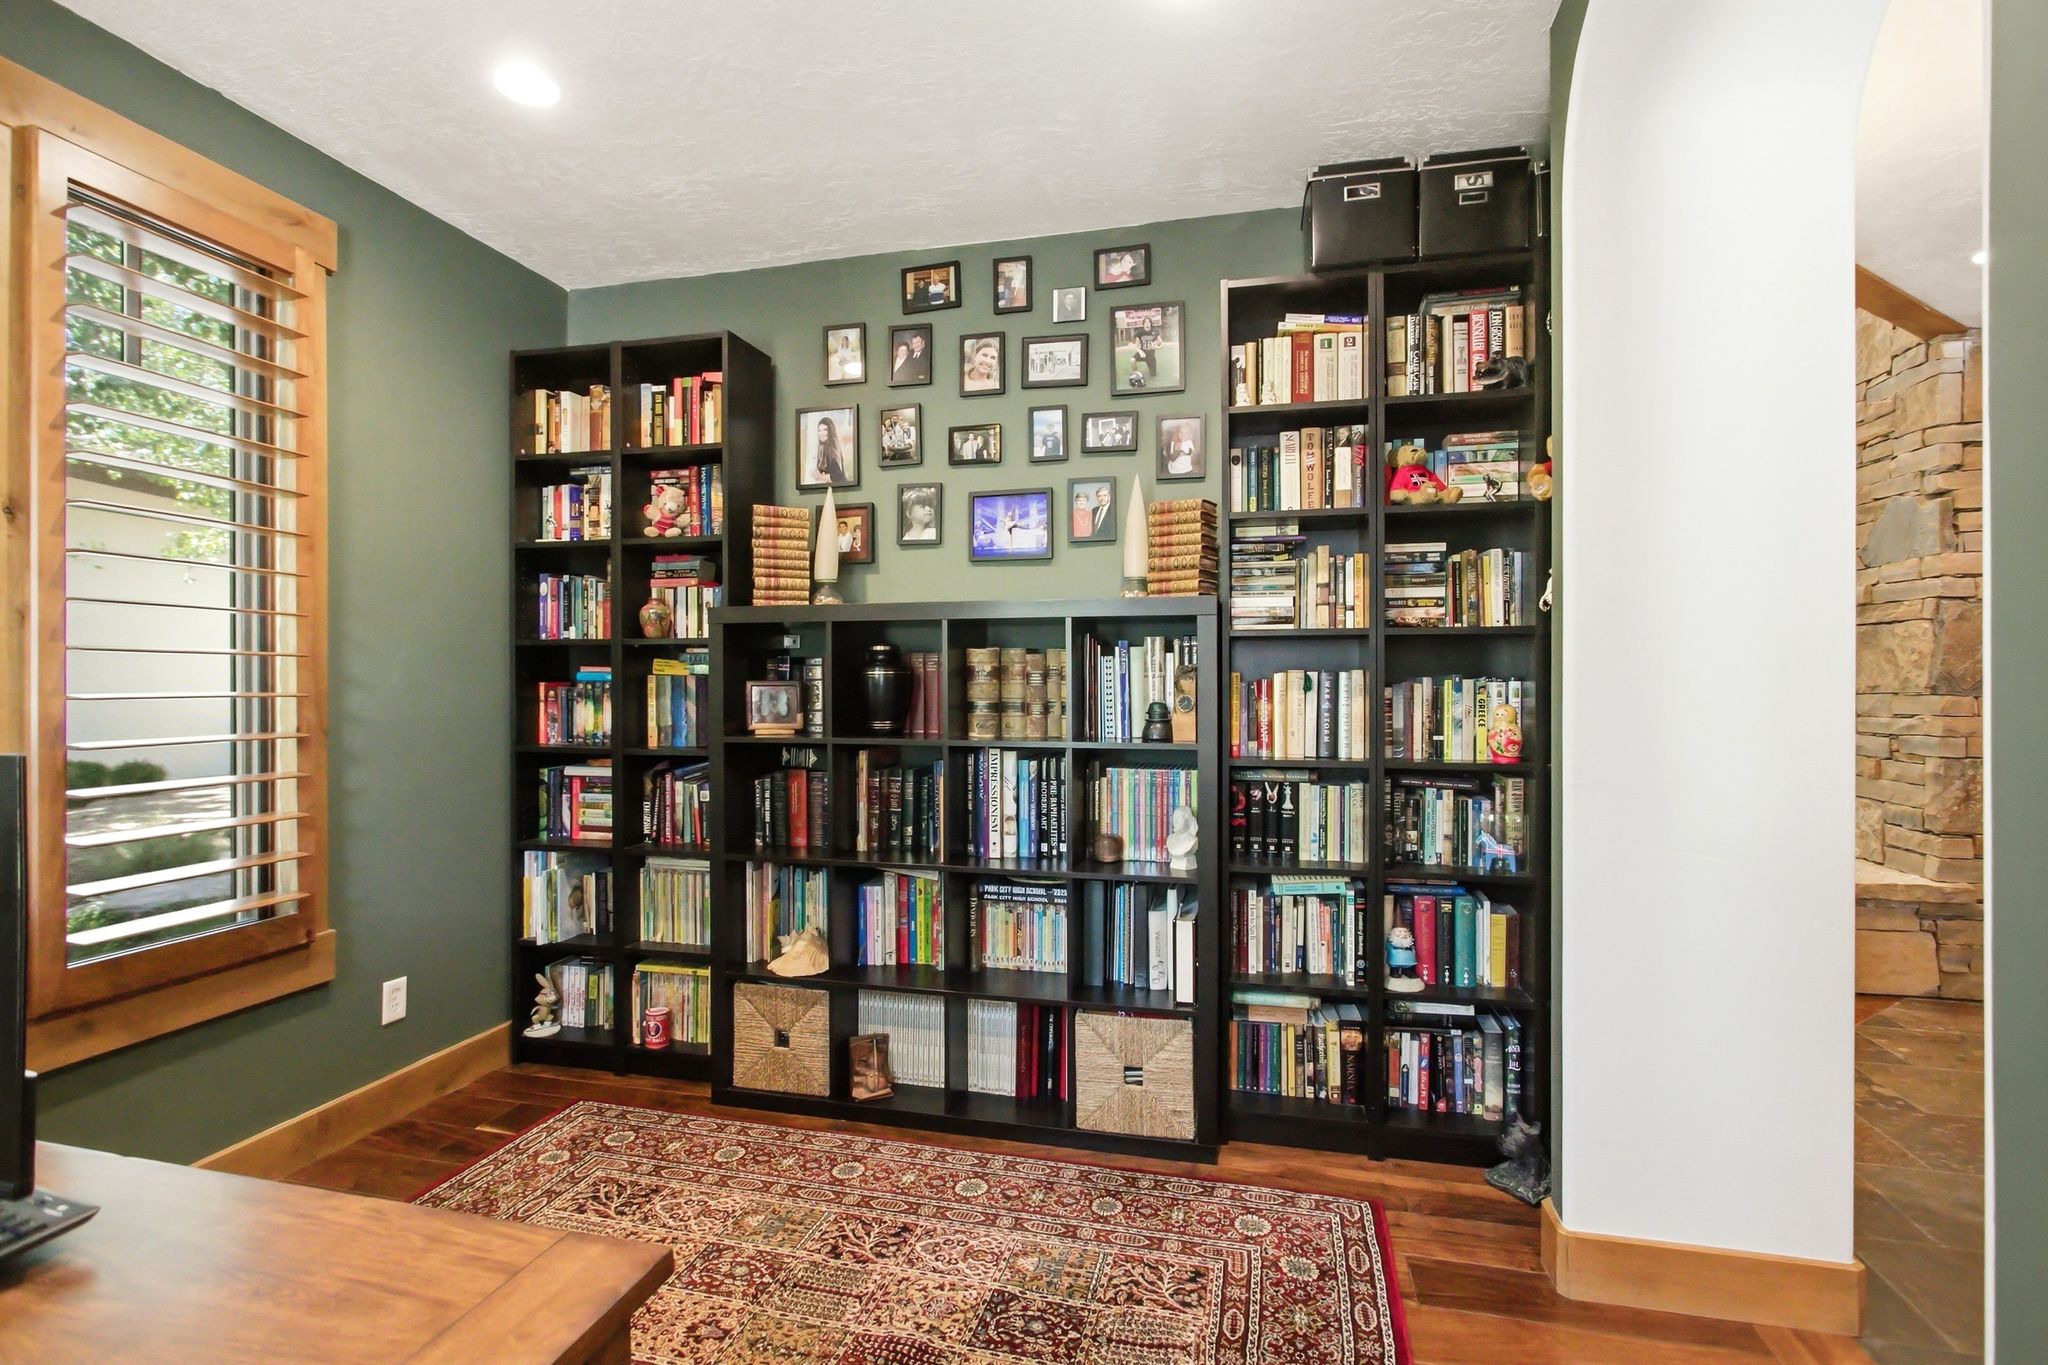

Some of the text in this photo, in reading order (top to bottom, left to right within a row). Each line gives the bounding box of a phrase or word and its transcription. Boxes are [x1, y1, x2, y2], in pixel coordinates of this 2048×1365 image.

[1324, 340, 1328, 348] 1
[1346, 338, 1353, 346] 2
[1472, 314, 1484, 351] BESTSELLER
[1491, 311, 1503, 352] JOHN GRISHAM
[1306, 433, 1314, 509] TOM WOLFE
[1478, 698, 1486, 727] GREECE
[1346, 1055, 1355, 1090] NARNIA
